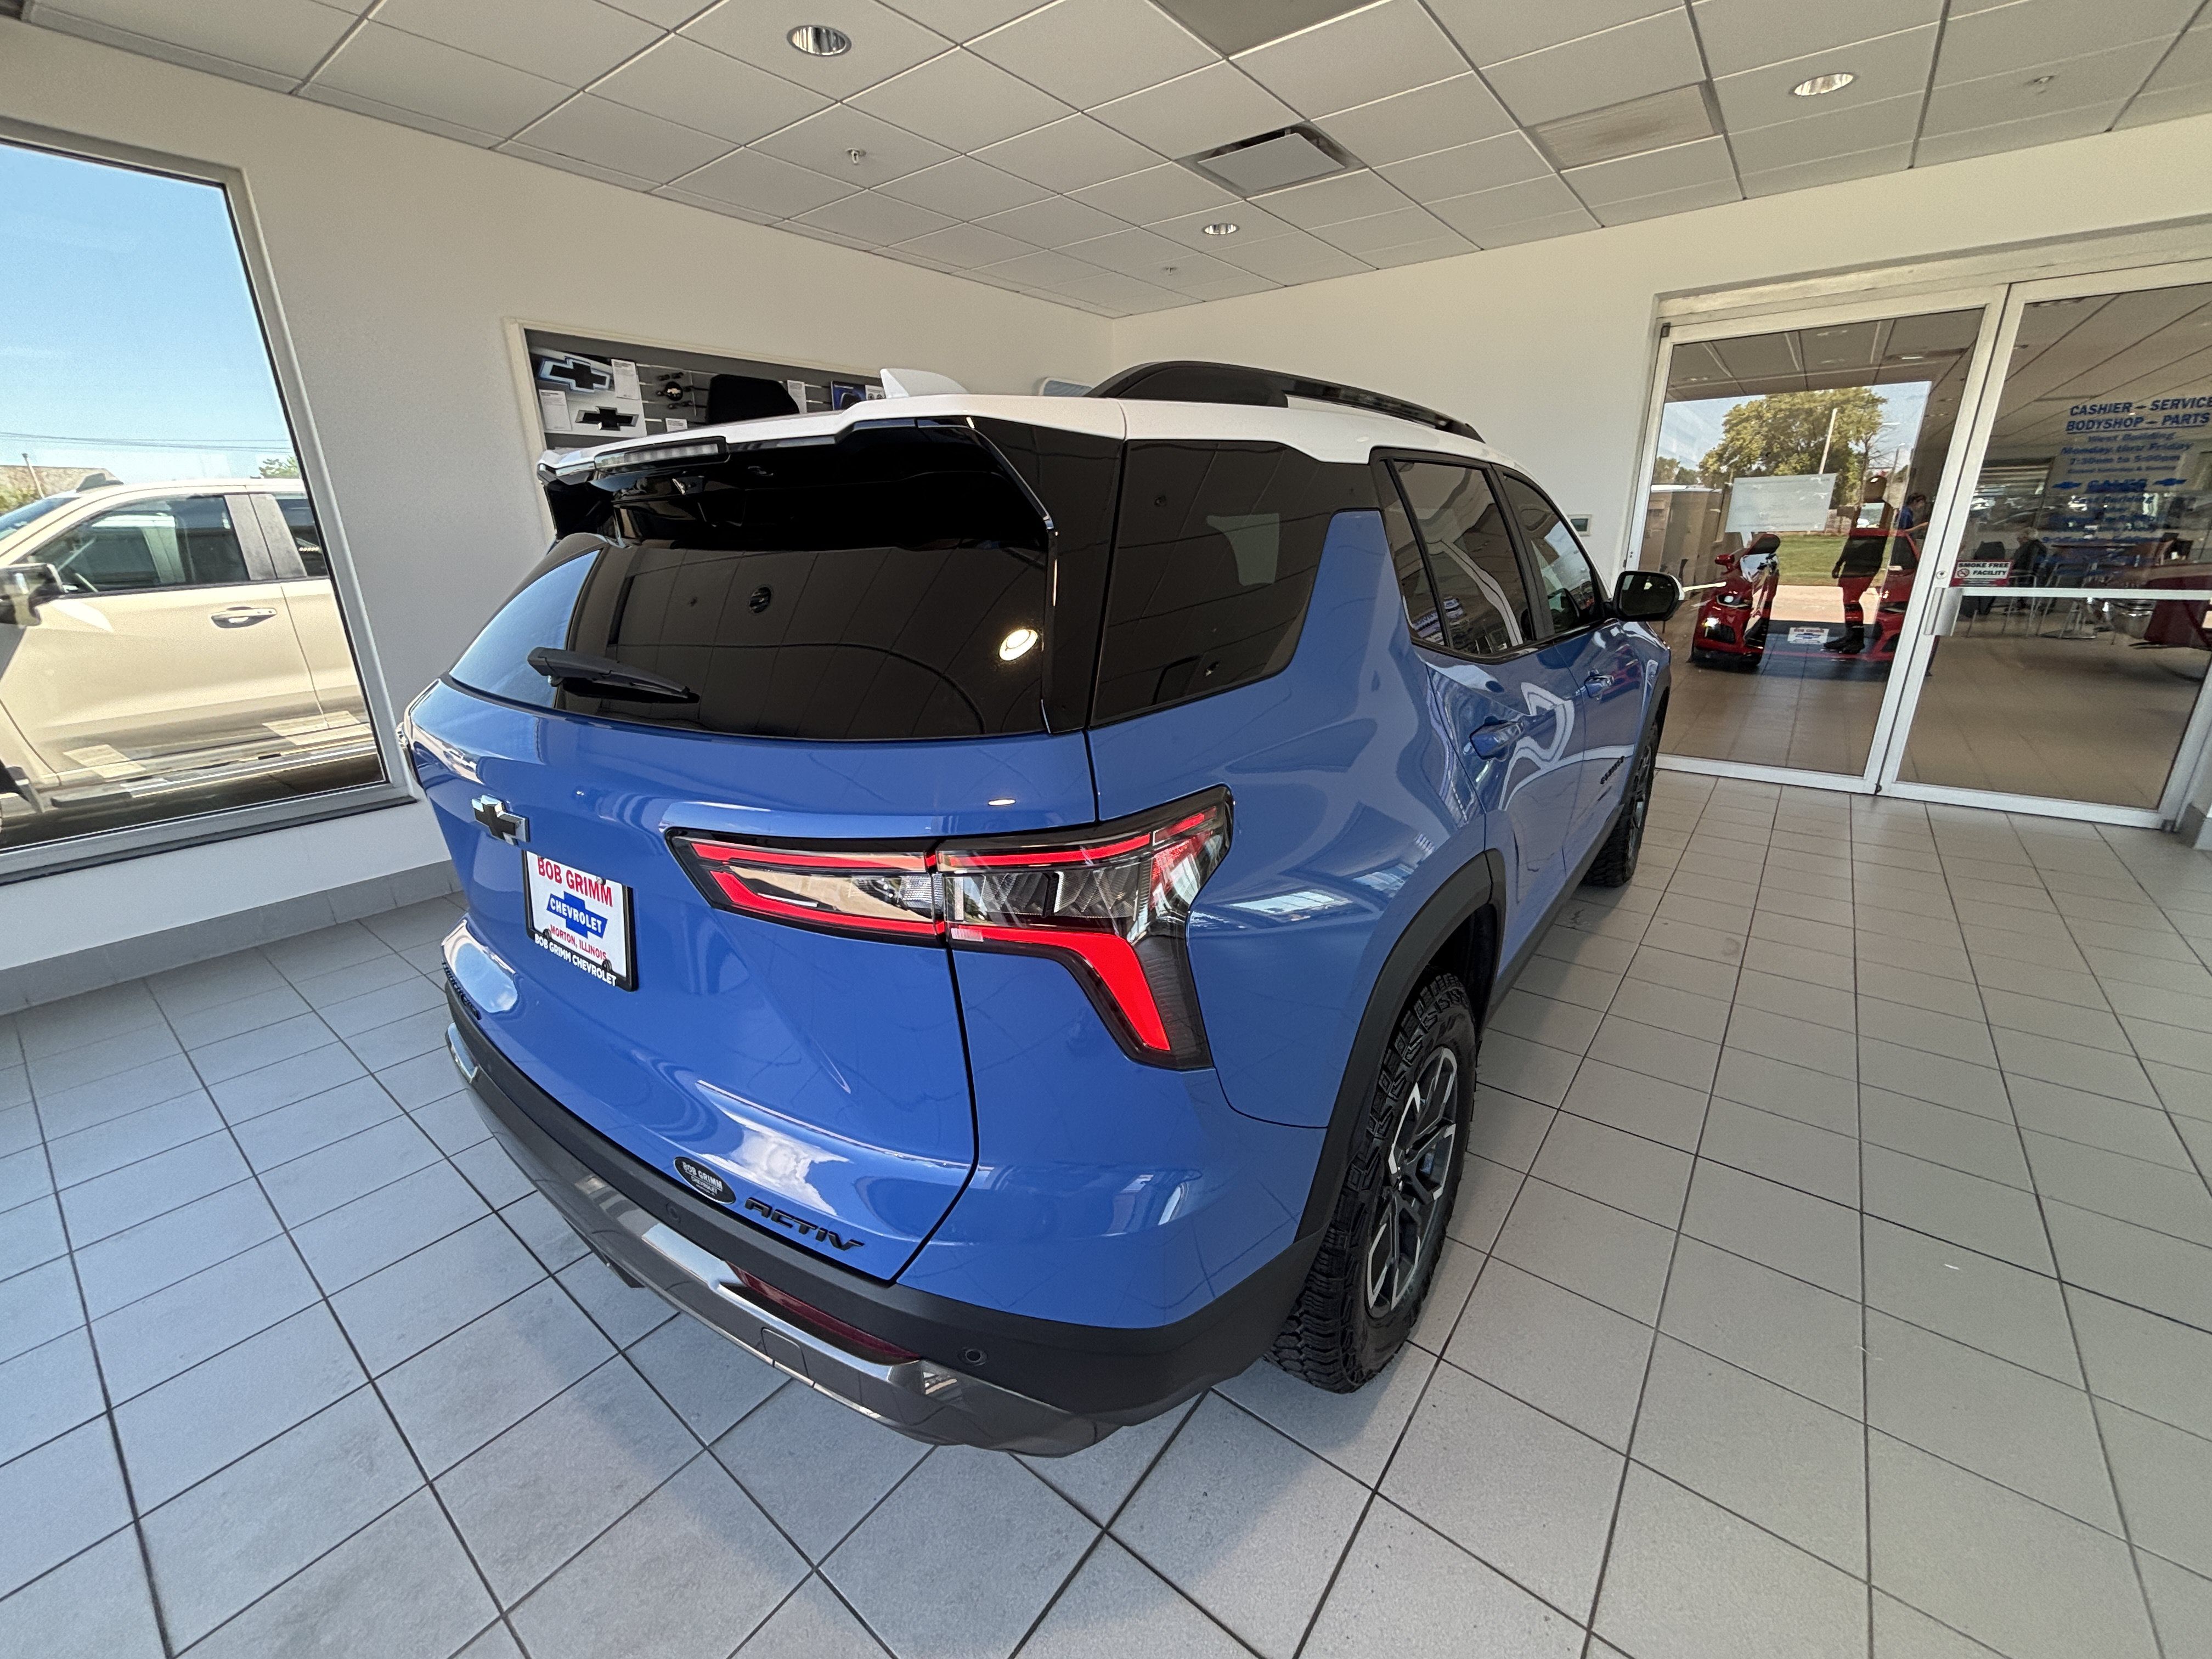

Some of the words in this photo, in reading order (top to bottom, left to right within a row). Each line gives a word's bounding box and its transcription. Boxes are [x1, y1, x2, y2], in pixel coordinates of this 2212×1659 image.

[2066, 417, 2144, 431] BODYSHOP
[2162, 412, 2210, 426] PARTS
[2070, 402, 2133, 416] CASHIER
[538, 856, 562, 884] BOB
[566, 870, 613, 907] GRIMM
[550, 898, 602, 933] CHEVROLET
[534, 933, 549, 949] BOB
[549, 941, 571, 963] GRIMM
[572, 955, 617, 986] CHEVROLET
[550, 924, 578, 949] MORTON,
[579, 939, 607, 961] ILLINOIS
[682, 1161, 697, 1176] BOB
[698, 1170, 723, 1190] GRIMM
[744, 1197, 865, 1251] ACTIV
